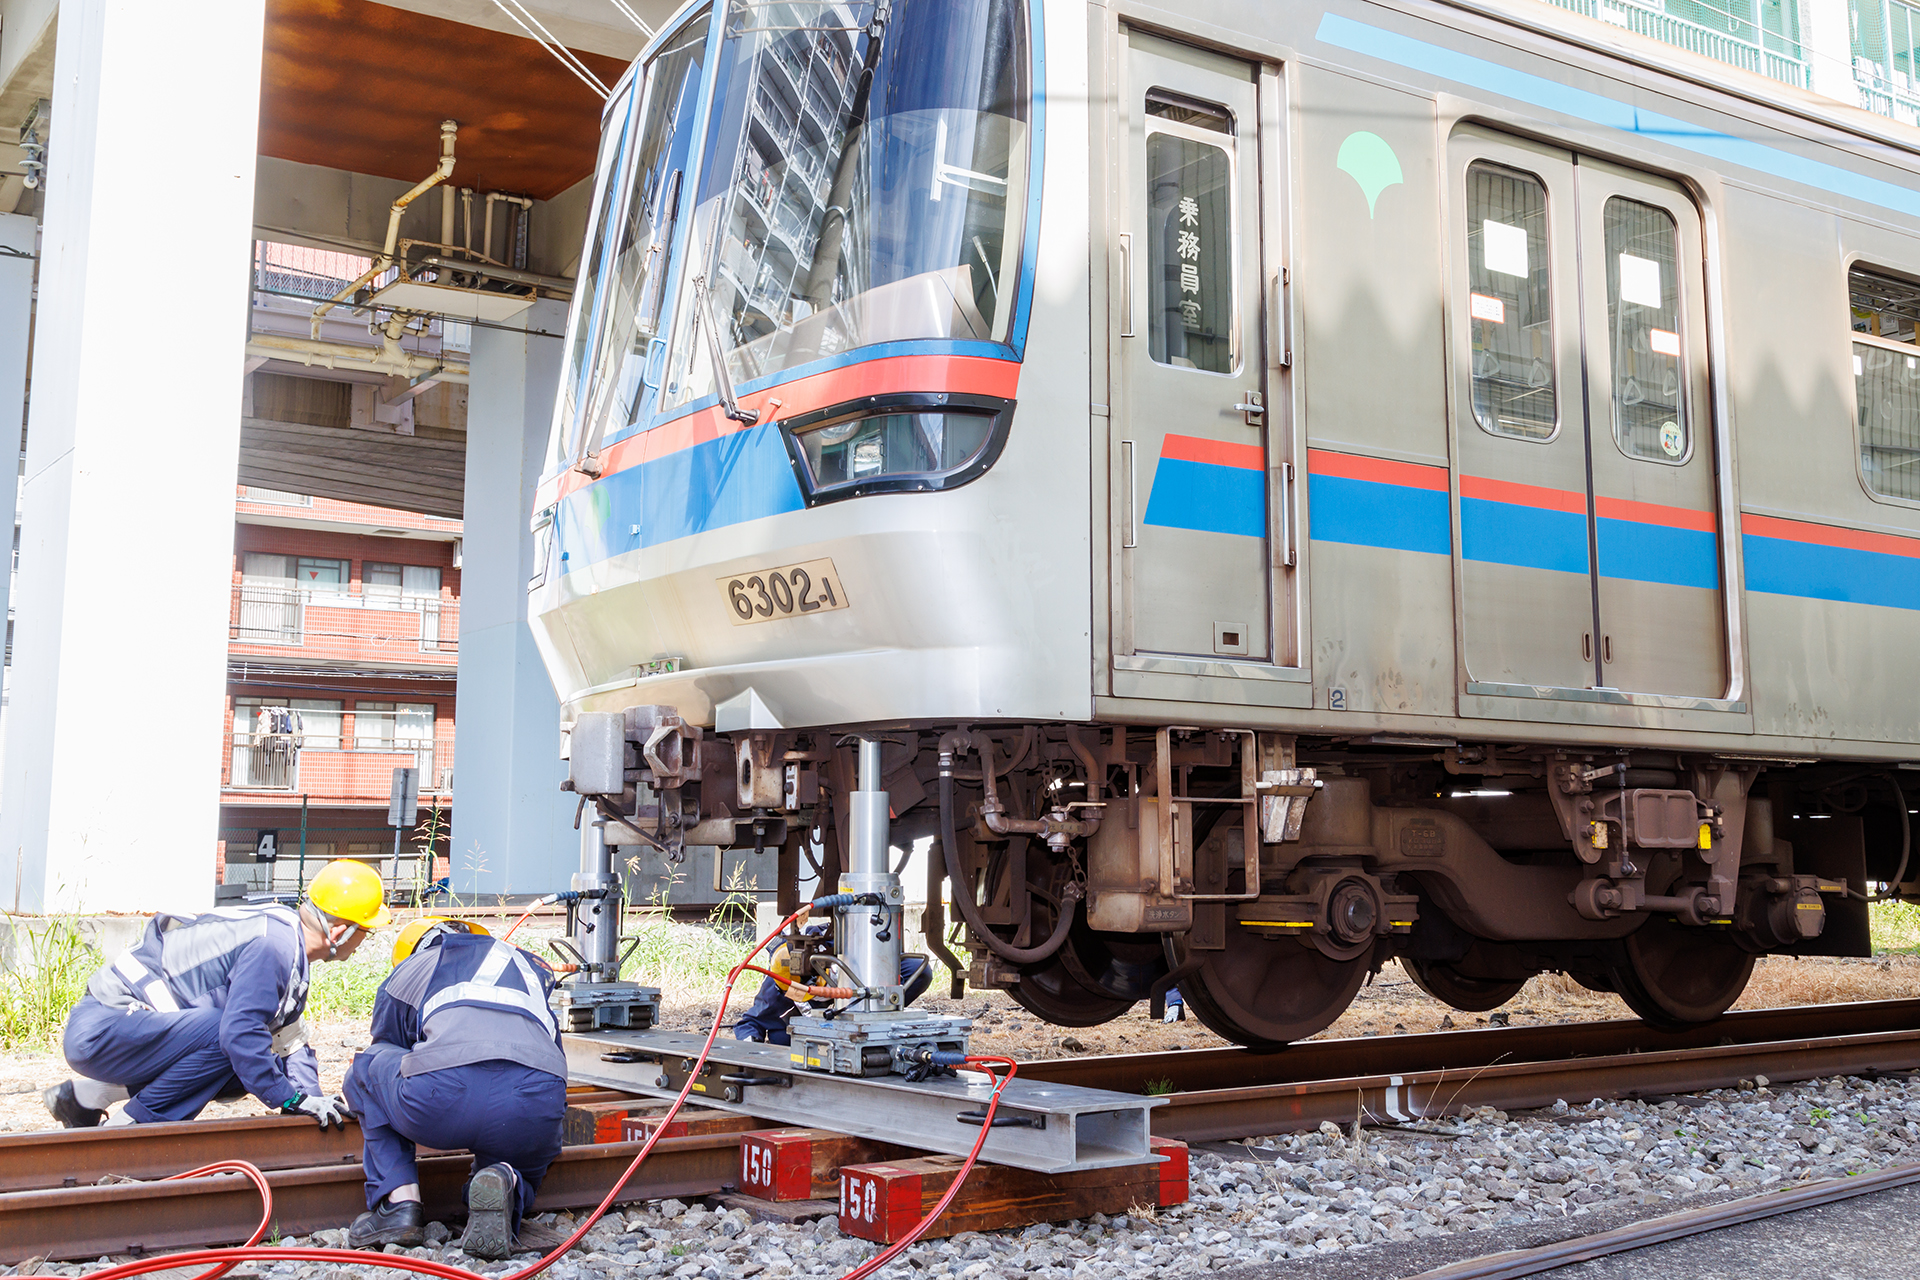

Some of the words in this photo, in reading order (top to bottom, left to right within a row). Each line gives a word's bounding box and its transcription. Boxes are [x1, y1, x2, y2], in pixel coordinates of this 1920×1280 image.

[1176, 196, 1201, 328] 乗務員室
[727, 567, 838, 620] 6302-1
[1332, 690, 1344, 708] 2
[258, 834, 276, 858] 4
[742, 1143, 773, 1188] 150
[840, 1174, 877, 1224] 150
